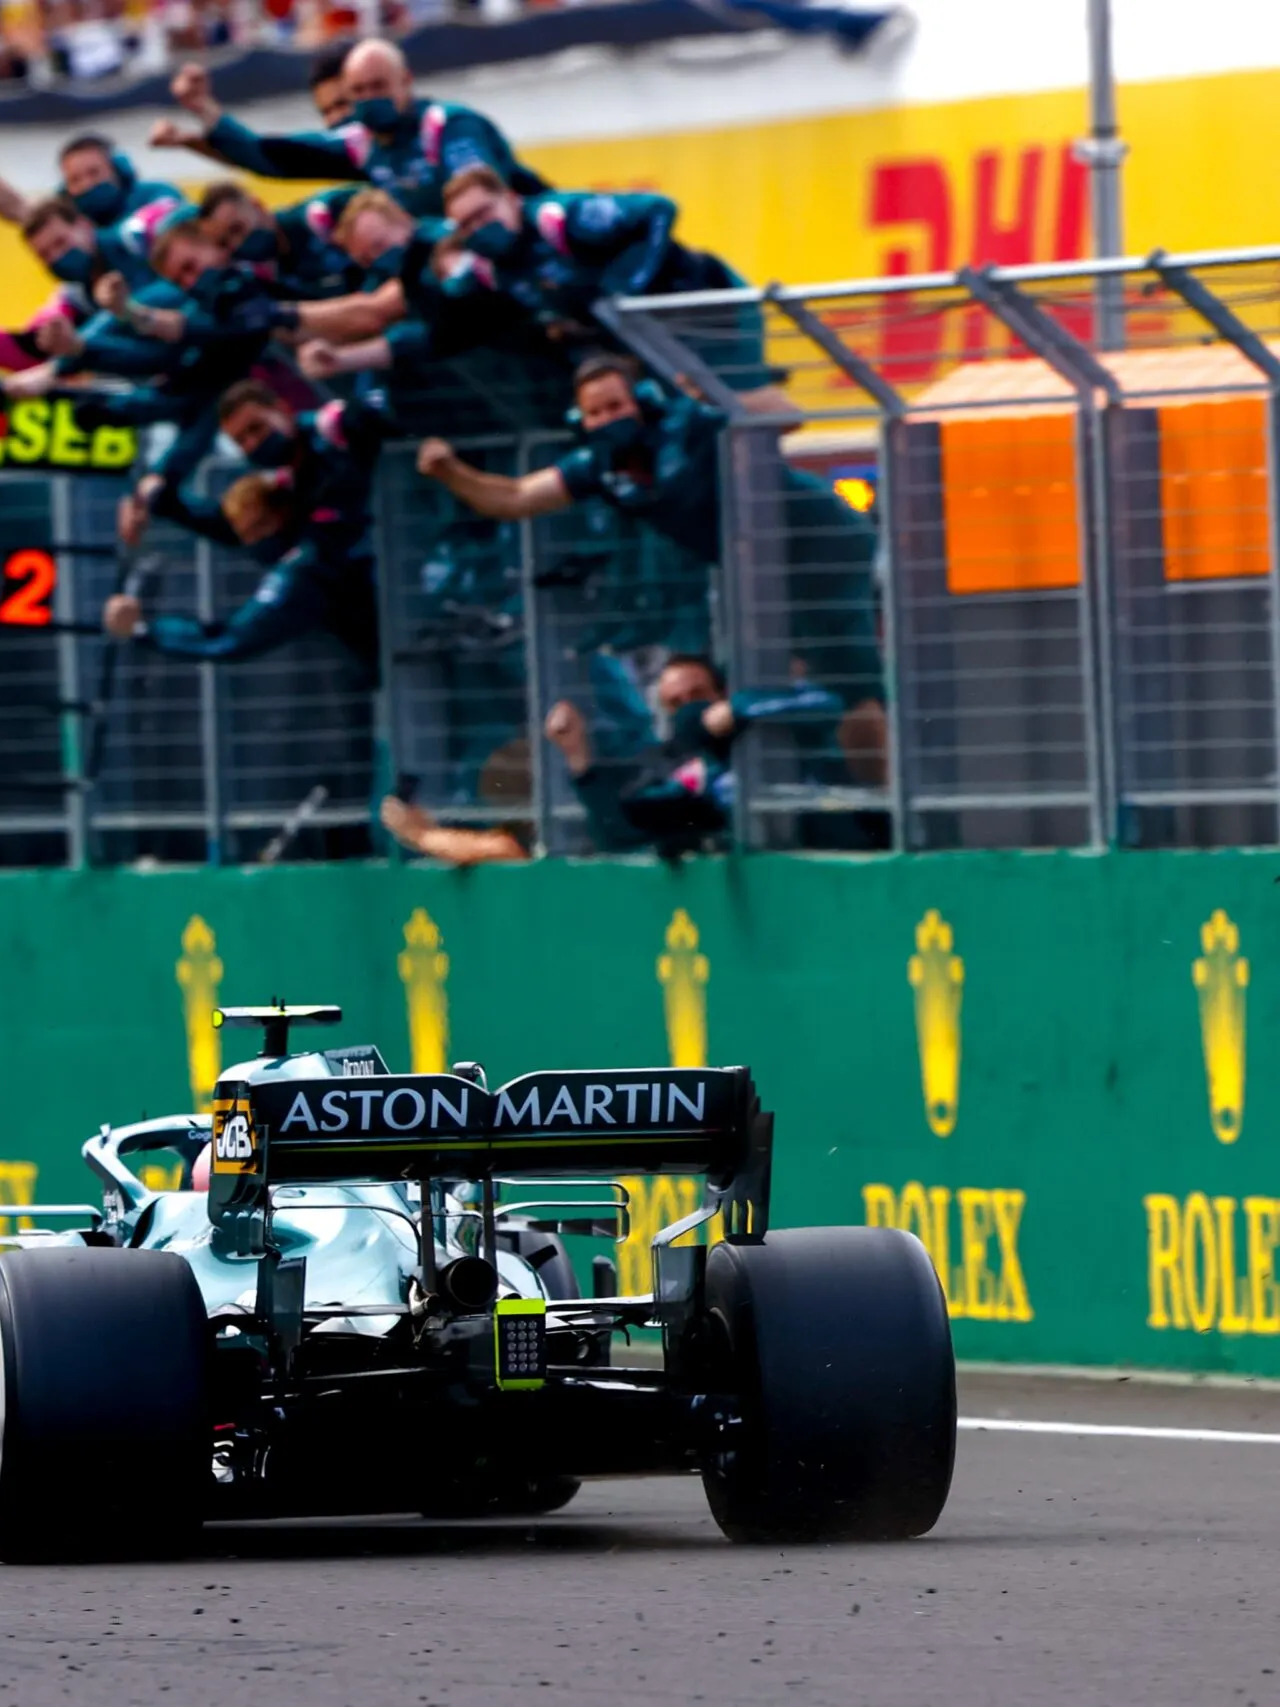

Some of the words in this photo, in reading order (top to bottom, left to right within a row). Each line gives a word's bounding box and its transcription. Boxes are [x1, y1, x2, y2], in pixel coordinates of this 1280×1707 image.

[280, 1088, 469, 1132] ASTON
[493, 1082, 706, 1127] MARTIN
[216, 1115, 252, 1158] JCB
